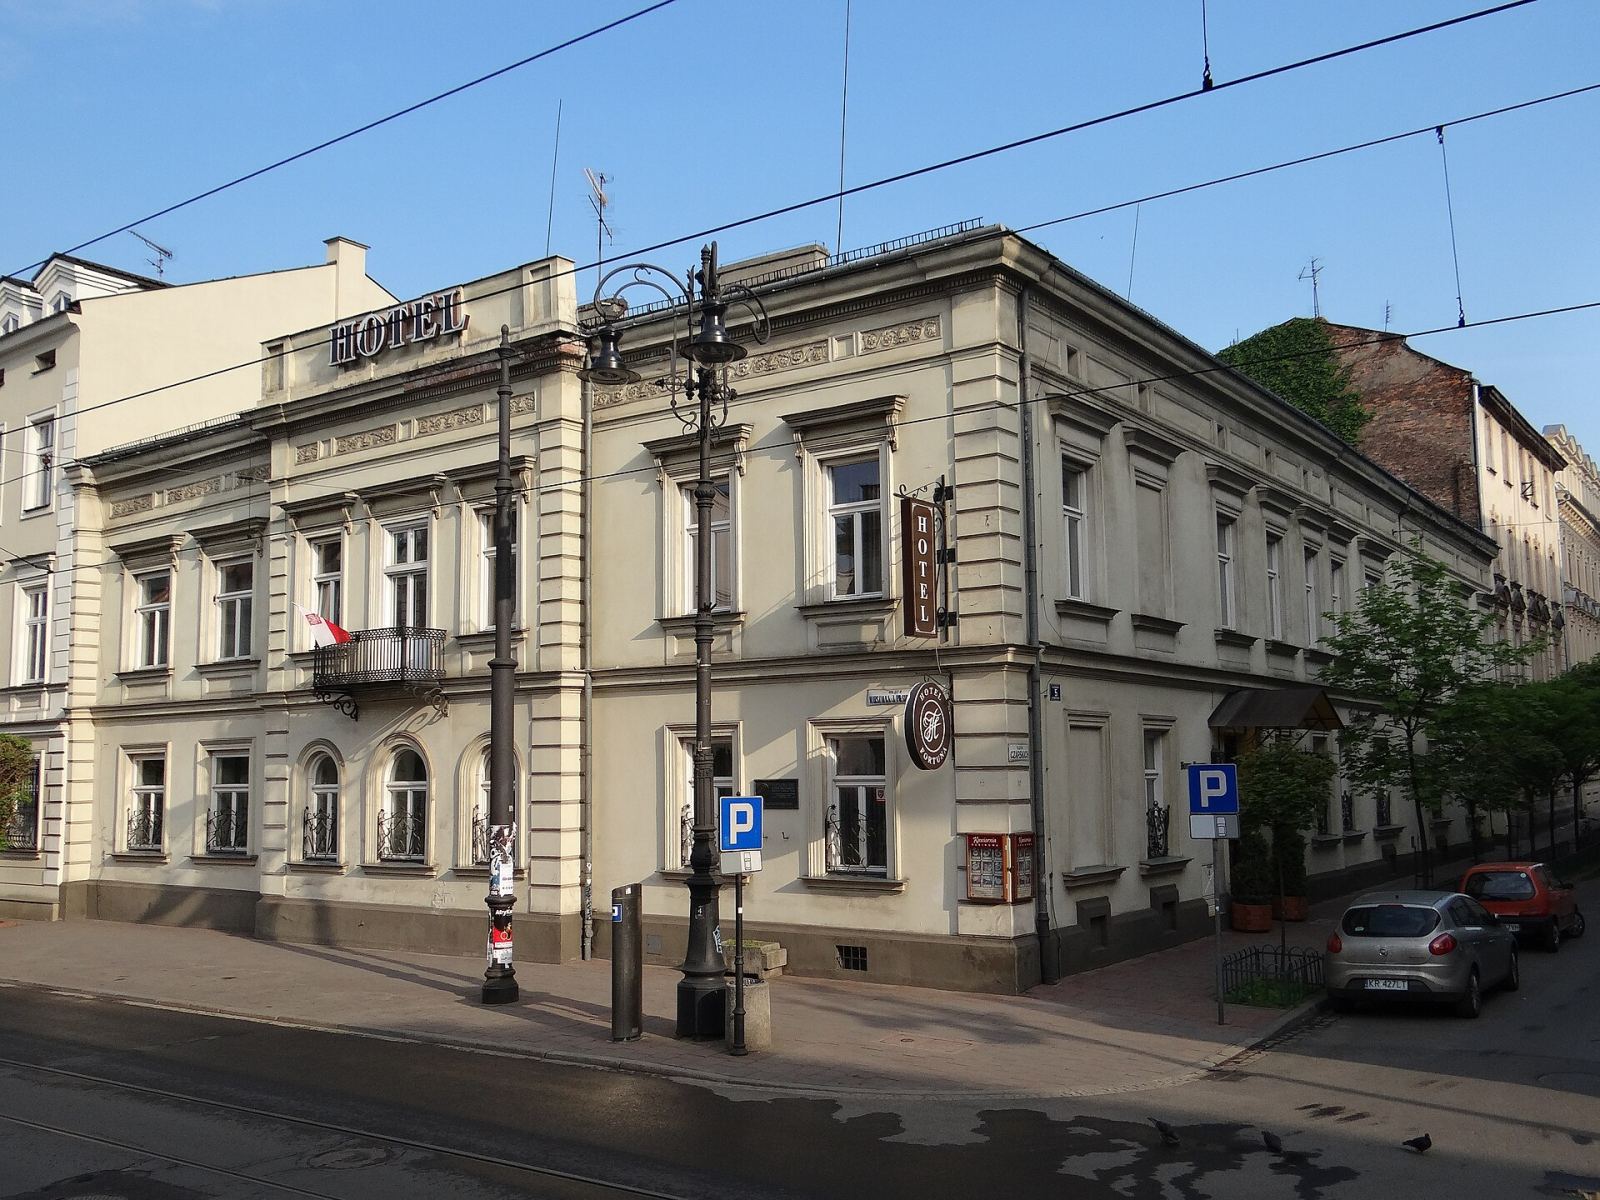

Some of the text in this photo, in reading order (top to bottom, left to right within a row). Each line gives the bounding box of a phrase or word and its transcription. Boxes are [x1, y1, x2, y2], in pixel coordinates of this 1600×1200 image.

[328, 290, 469, 366] HOTEL
[917, 515, 929, 622] HOTEL
[919, 686, 942, 701] HOTEL
[919, 747, 948, 765] FORTUNA
[1200, 770, 1227, 808] P
[729, 802, 754, 845] P
[1367, 979, 1408, 989] KR 427LT
